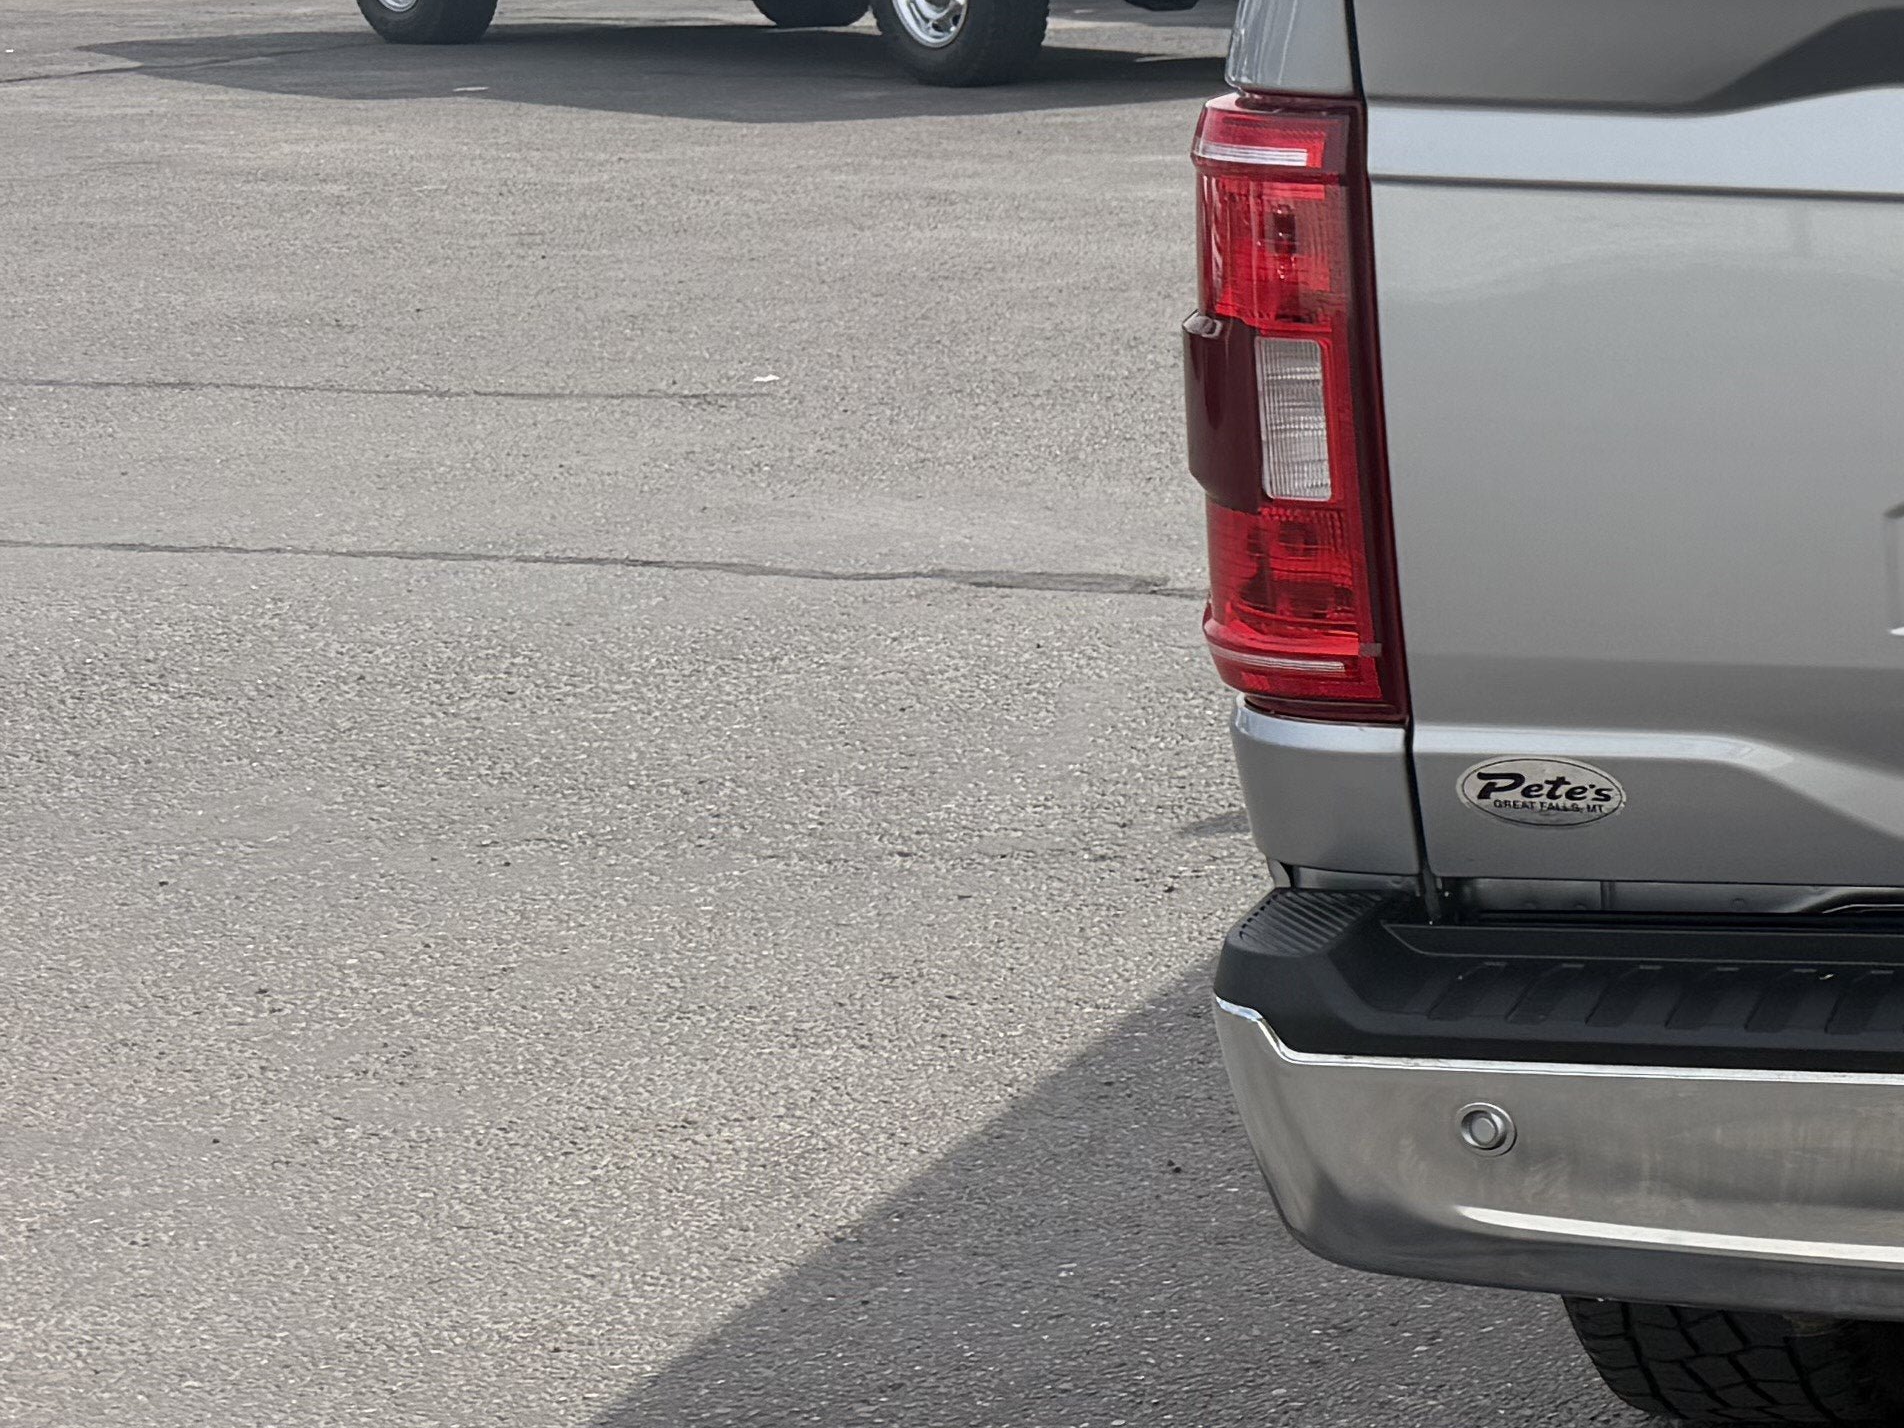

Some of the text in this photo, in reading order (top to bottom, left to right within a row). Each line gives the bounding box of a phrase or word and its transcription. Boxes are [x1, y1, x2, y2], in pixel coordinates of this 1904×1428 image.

[1477, 772, 1613, 802] Pete's
[1493, 799, 1535, 810] GREAT
[1587, 803, 1604, 813] MT
